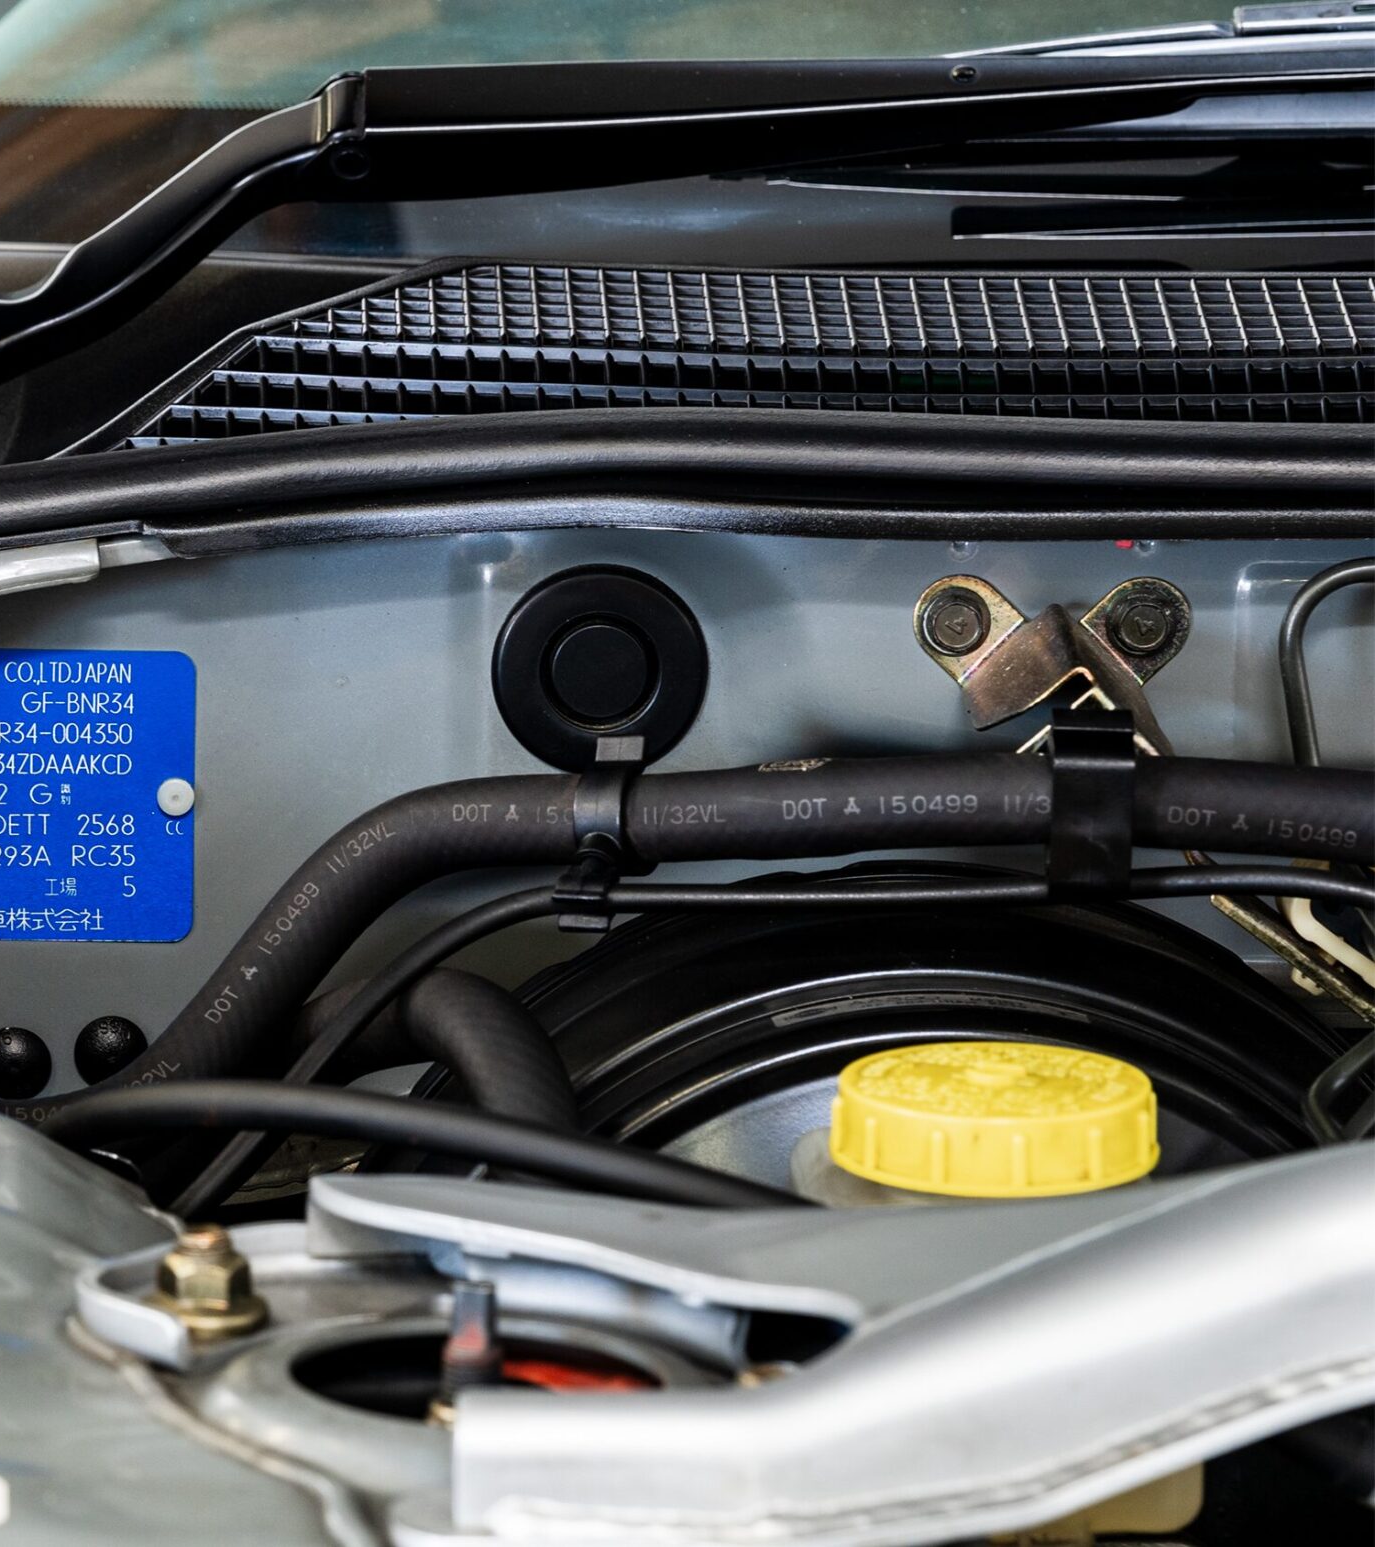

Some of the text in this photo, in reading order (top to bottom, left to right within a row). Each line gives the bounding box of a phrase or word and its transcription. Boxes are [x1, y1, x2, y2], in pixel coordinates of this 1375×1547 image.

[21, 691, 134, 714] GF-BNR34
[29, 783, 53, 805] G
[452, 804, 492, 822] DOT
[782, 798, 828, 820] DOT
[879, 794, 979, 815] 150499
[77, 813, 136, 836] 2568
[1166, 805, 1358, 848] DOT 150499
[72, 845, 136, 867] RC35
[44, 875, 137, 898] 工場 5
[204, 985, 239, 1025] DOT
[257, 882, 320, 955] 150499
